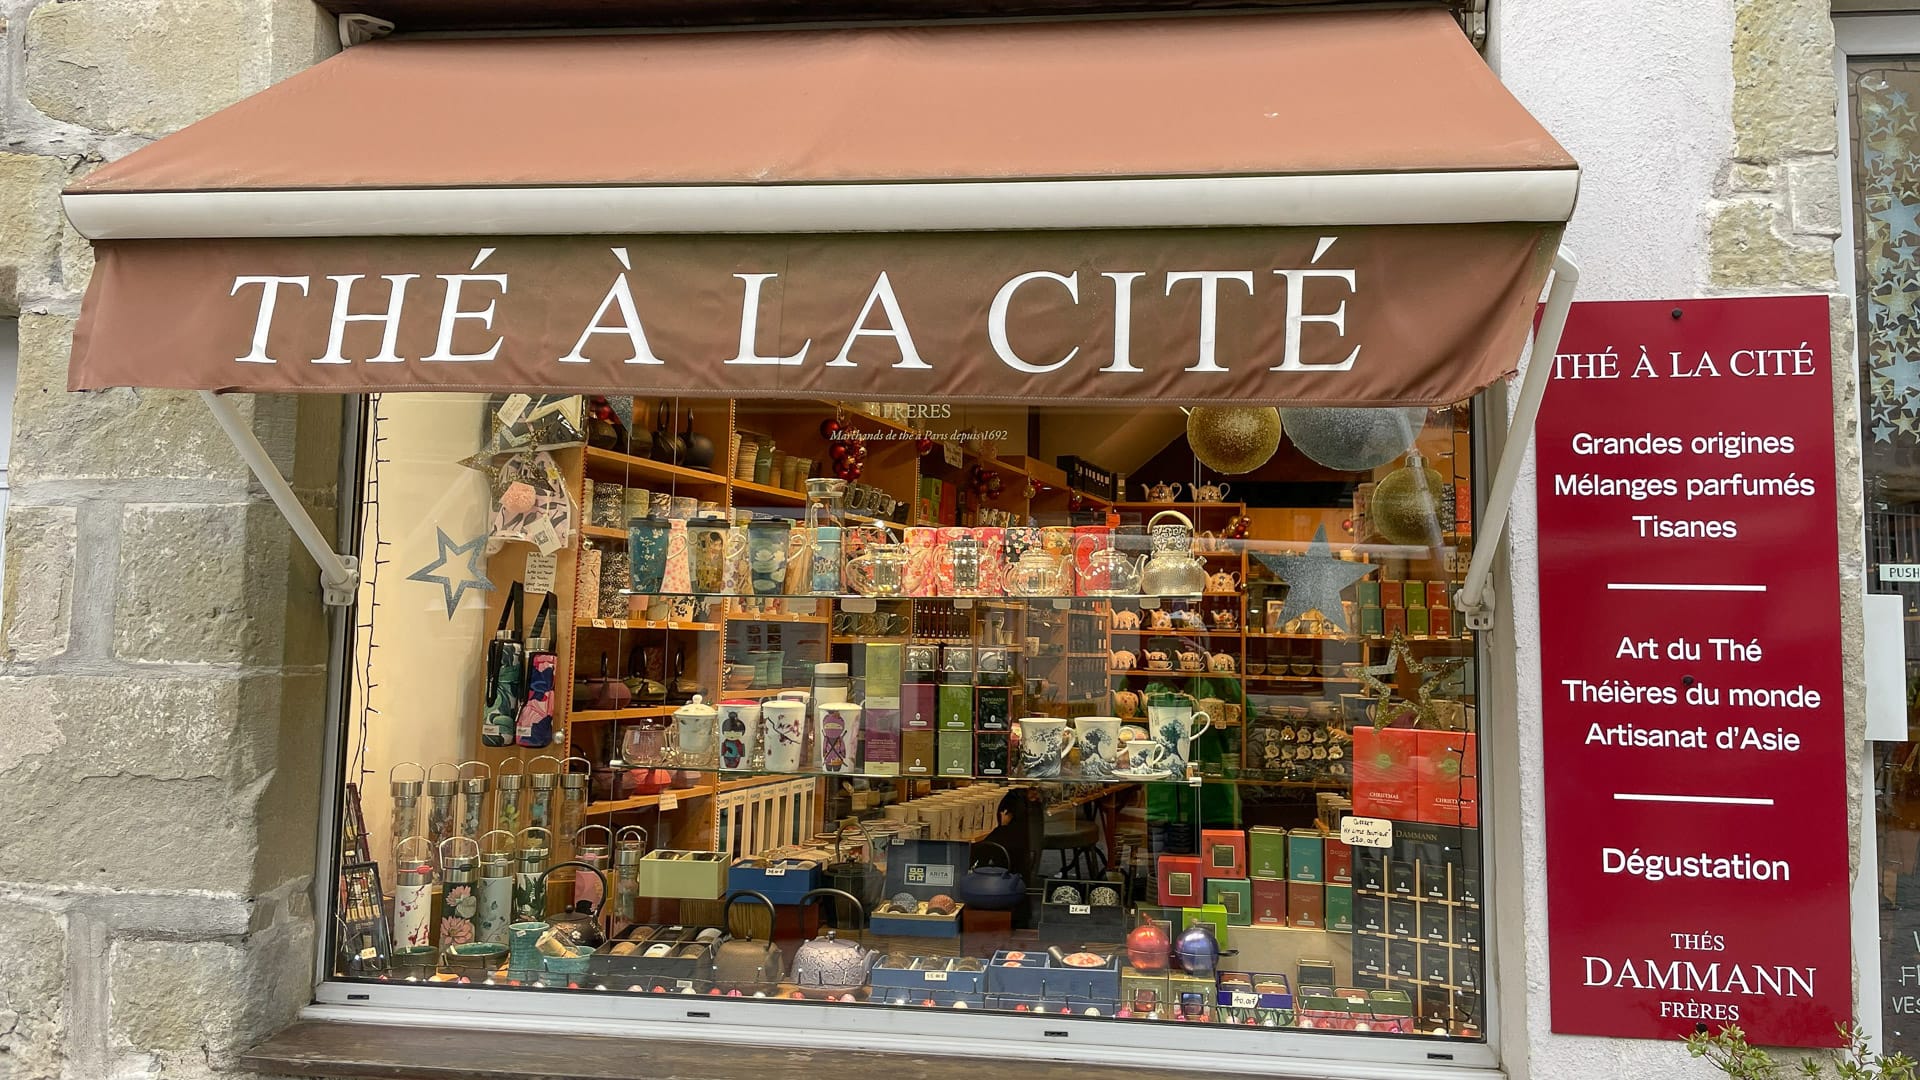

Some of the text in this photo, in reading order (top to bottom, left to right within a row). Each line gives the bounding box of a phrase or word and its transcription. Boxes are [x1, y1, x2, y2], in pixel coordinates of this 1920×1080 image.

[231, 237, 1360, 372] THÉ À LA CITÉ
[1553, 342, 1815, 379] THÉ À LA CITÉ
[829, 430, 884, 441] Marchands
[886, 430, 897, 441] de
[916, 430, 923, 441] à
[924, 430, 949, 441] Paris
[950, 430, 981, 445] depuis
[984, 430, 1008, 441] 1692
[1573, 432, 1794, 458] Grandes origines
[1556, 473, 1815, 500] Mélanges parfumés
[1632, 516, 1737, 537] Tisanes
[1889, 567, 1920, 578] PUSH
[1616, 637, 1761, 661] Art du Thé
[1562, 680, 1820, 708] Théières du monde
[1585, 723, 1800, 751] Artisanat d'Asie
[1603, 848, 1789, 880] Dégustation
[1671, 931, 1724, 951] THÉS
[1583, 957, 1816, 998] DAMMANN
[1661, 999, 1739, 1020] FRÈRES
